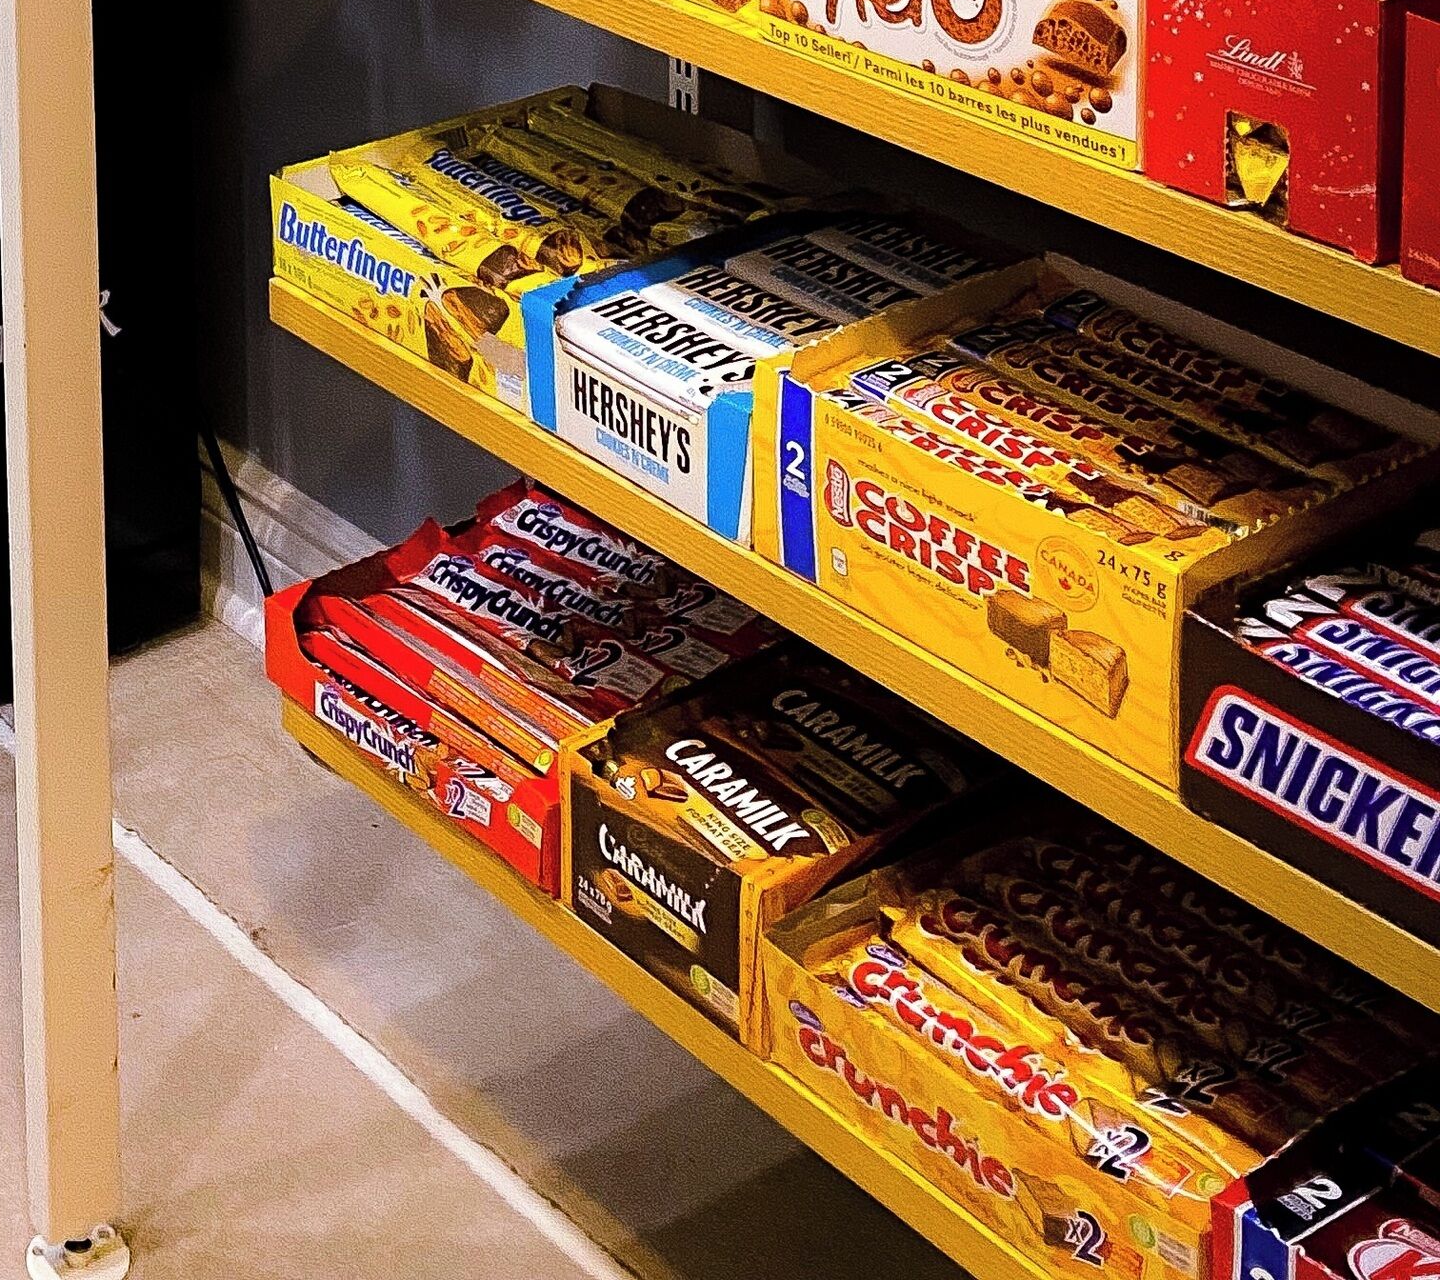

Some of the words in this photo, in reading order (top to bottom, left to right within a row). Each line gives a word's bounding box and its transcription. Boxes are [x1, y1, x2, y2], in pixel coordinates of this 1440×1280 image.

[769, 22, 791, 45] Top
[794, 31, 810, 48] 10
[864, 57, 903, 83] Parmi
[905, 71, 927, 90] les
[929, 81, 946, 98] 10
[948, 86, 993, 116] barres
[995, 102, 1018, 122] les
[1021, 115, 1051, 138] plus
[1054, 126, 1118, 159] vendues
[1218, 34, 1288, 72] Lindt
[278, 201, 416, 298] Butterfinger
[591, 293, 757, 382] HERSHEY'S
[886, 363, 910, 382] 2
[573, 366, 692, 474] HERSHEY'S
[786, 440, 806, 481] 2
[855, 480, 1031, 592] COFFEE
[857, 510, 996, 596] CRISP
[1039, 548, 1096, 592] CANADA
[1096, 549, 1116, 568] 24
[1118, 563, 1129, 576] x
[1132, 565, 1152, 586] 75
[1156, 581, 1168, 600] g
[771, 688, 926, 788] CARAMILK
[664, 739, 810, 852] CARAMILK
[685, 806, 724, 840] FORMAT
[706, 810, 731, 834] KING
[729, 830, 752, 852] SIZE
[1206, 702, 1440, 883] SNICKE
[598, 824, 708, 934] CARAMILK
